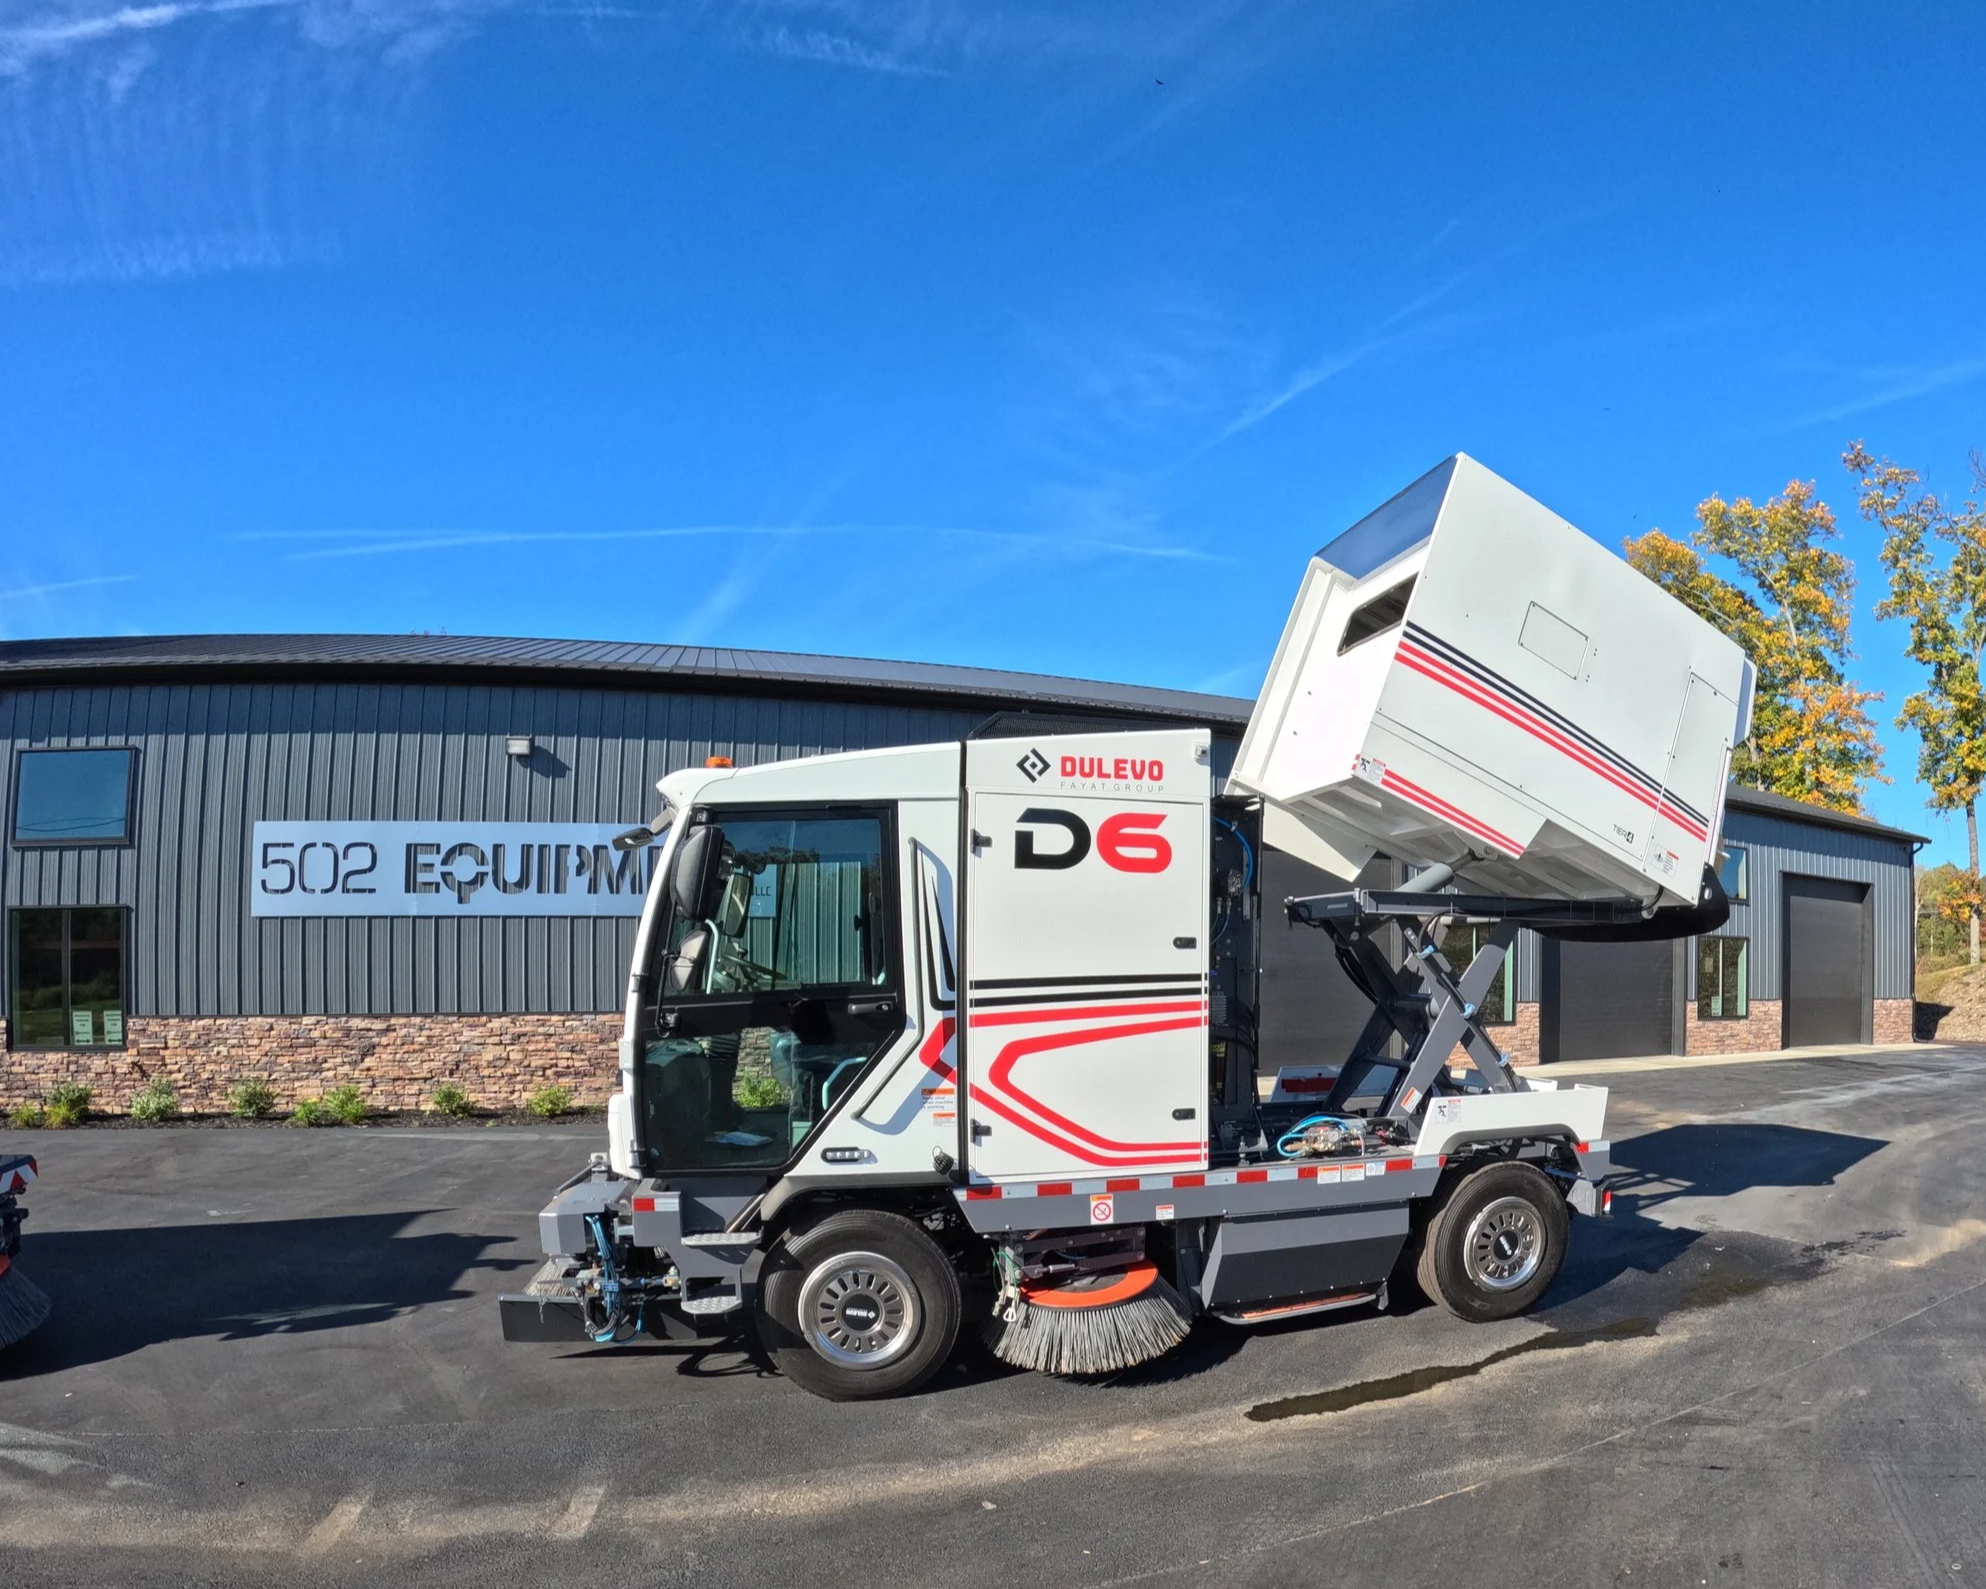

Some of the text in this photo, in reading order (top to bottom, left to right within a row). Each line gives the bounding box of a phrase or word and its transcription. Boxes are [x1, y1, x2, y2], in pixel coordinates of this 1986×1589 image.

[1060, 781, 1164, 793] FAYAT GROUP
[1061, 756, 1163, 781] DULEVO
[1014, 807, 1173, 874] D6
[261, 842, 377, 895] 502
